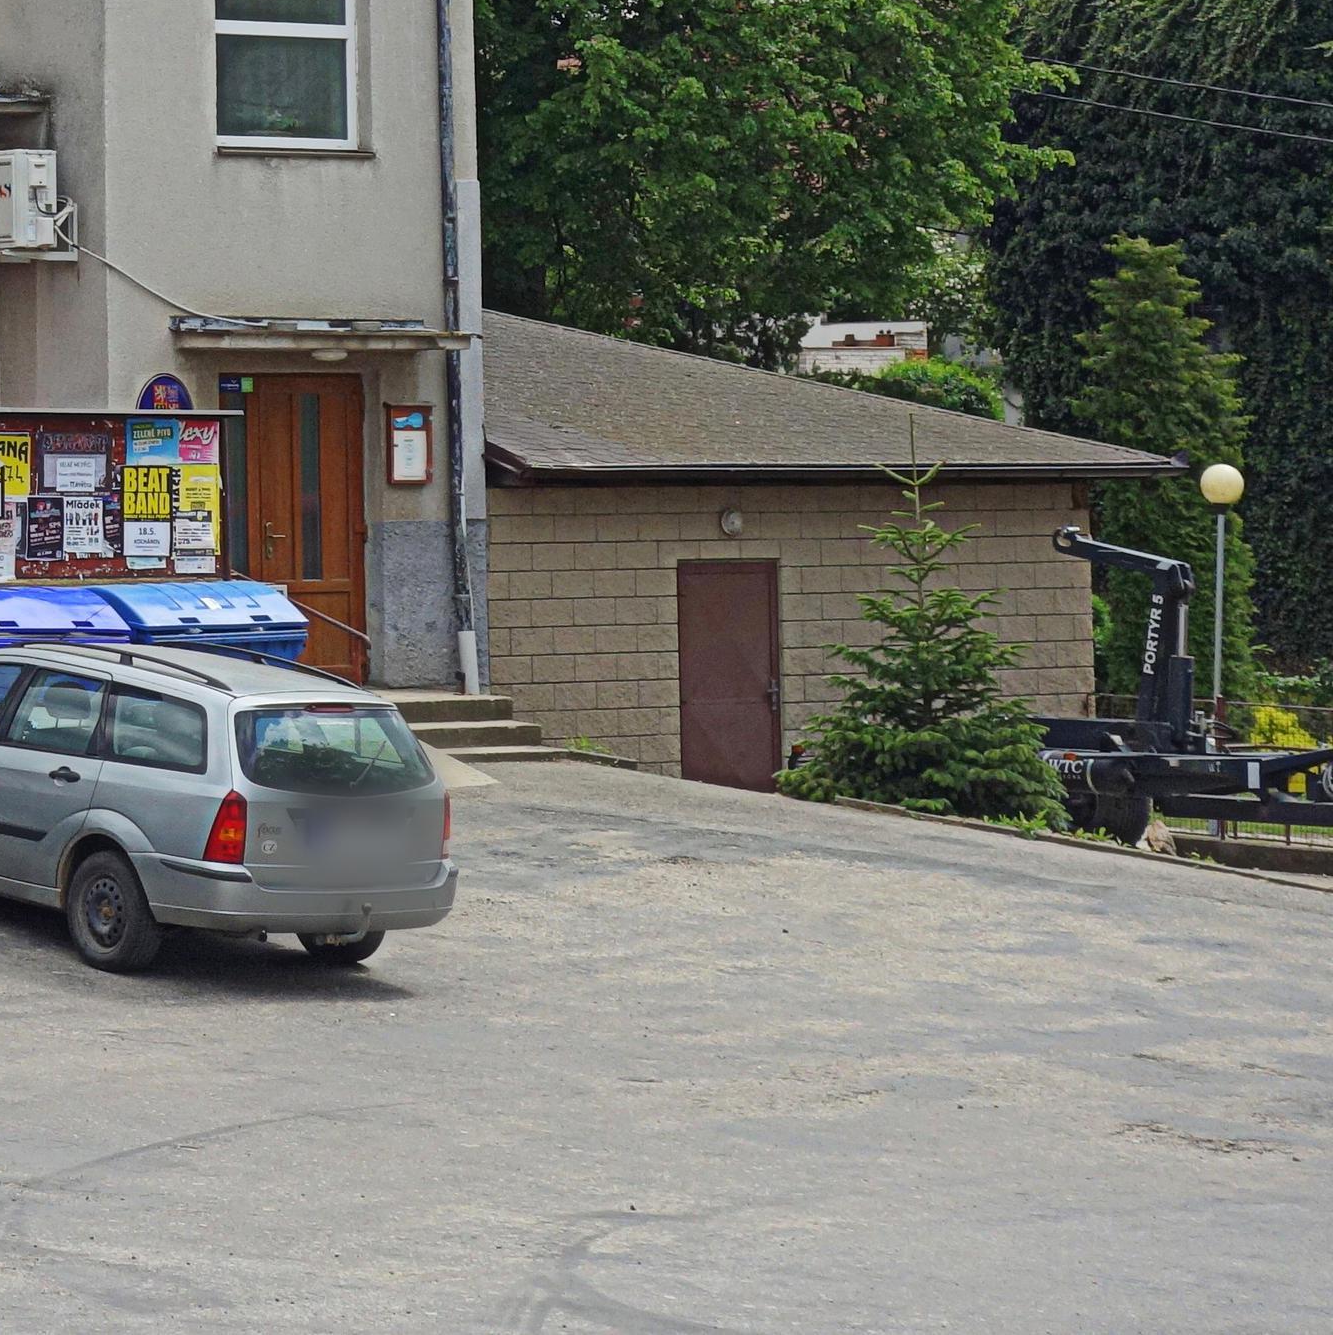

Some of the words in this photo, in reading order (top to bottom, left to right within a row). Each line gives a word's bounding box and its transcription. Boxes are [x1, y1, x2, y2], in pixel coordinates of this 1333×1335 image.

[123, 467, 170, 492] BEAT
[123, 492, 170, 515] BAND
[138, 527, 157, 536] 18.5.
[1152, 594, 1164, 605] 5
[1143, 608, 1163, 675] PORTYR
